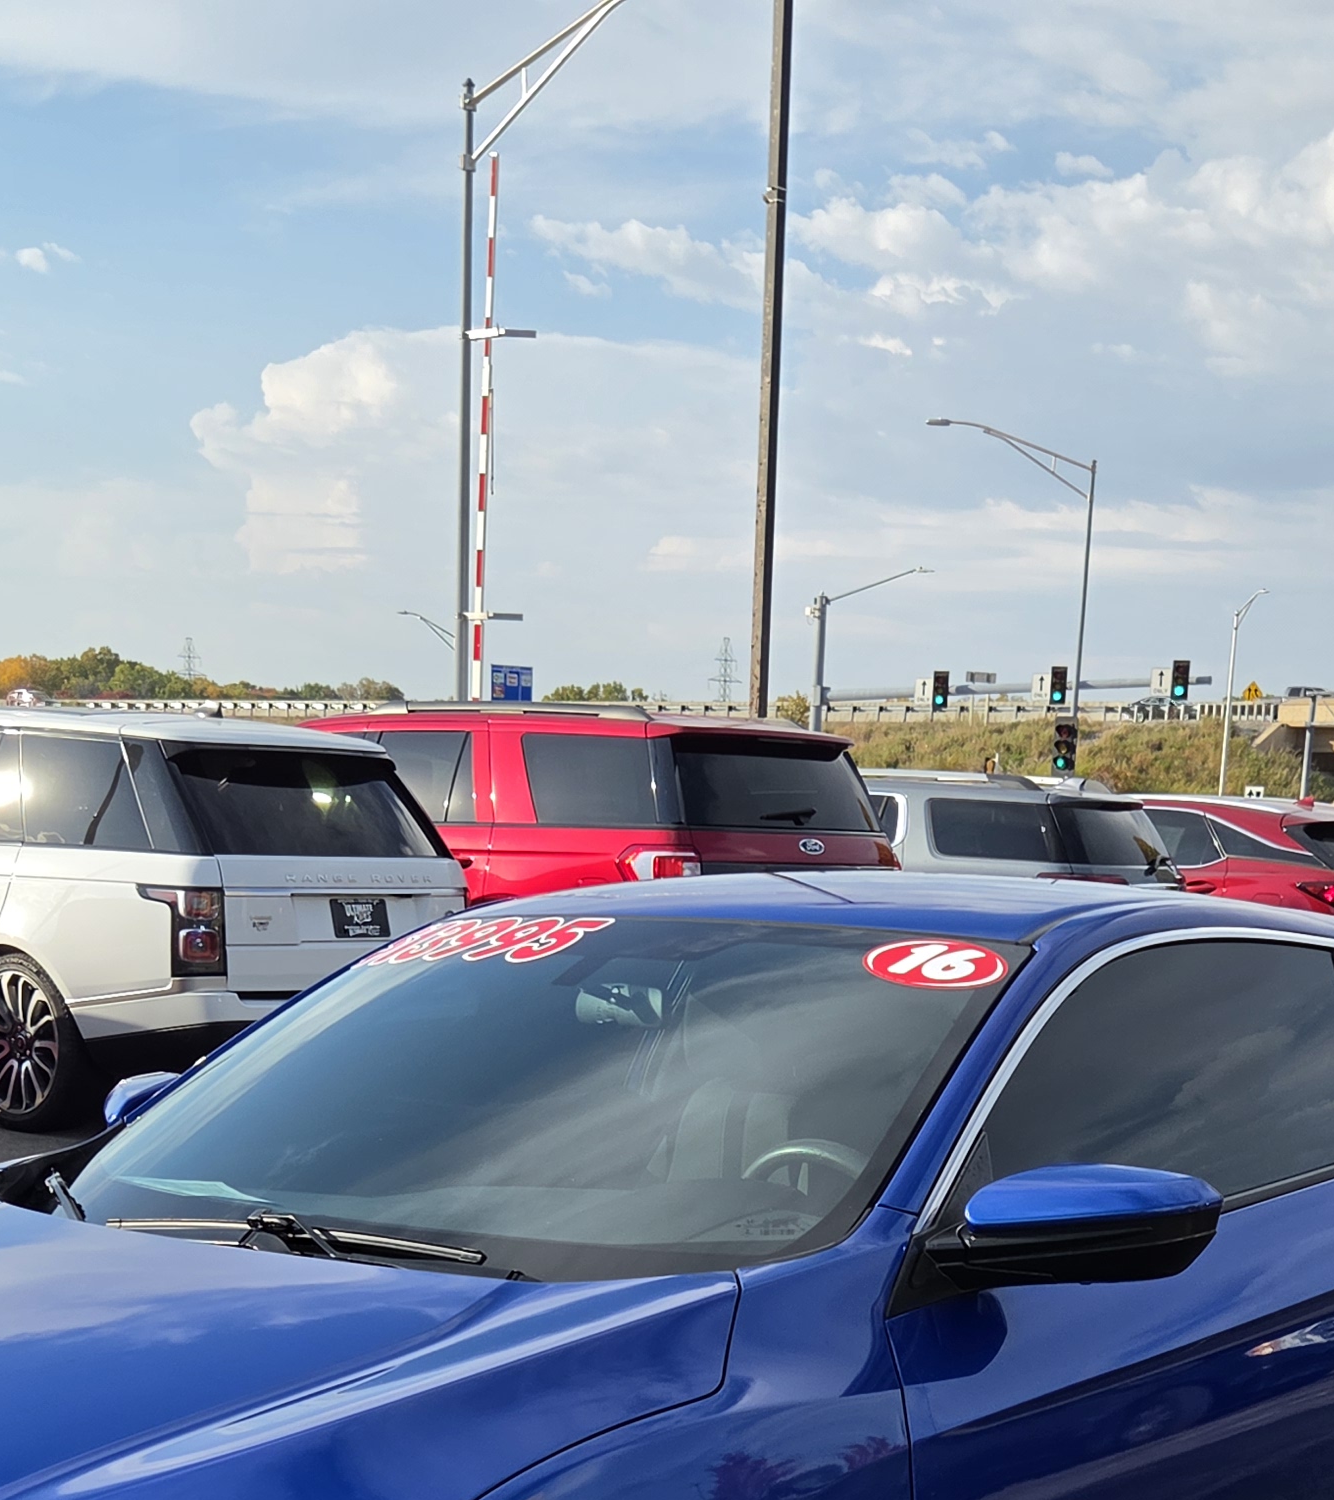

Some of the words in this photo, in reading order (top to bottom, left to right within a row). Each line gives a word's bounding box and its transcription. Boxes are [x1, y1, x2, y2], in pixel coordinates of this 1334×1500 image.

[285, 873, 357, 884] RANGE
[370, 873, 432, 884] ROVER
[887, 944, 986, 980] 16
